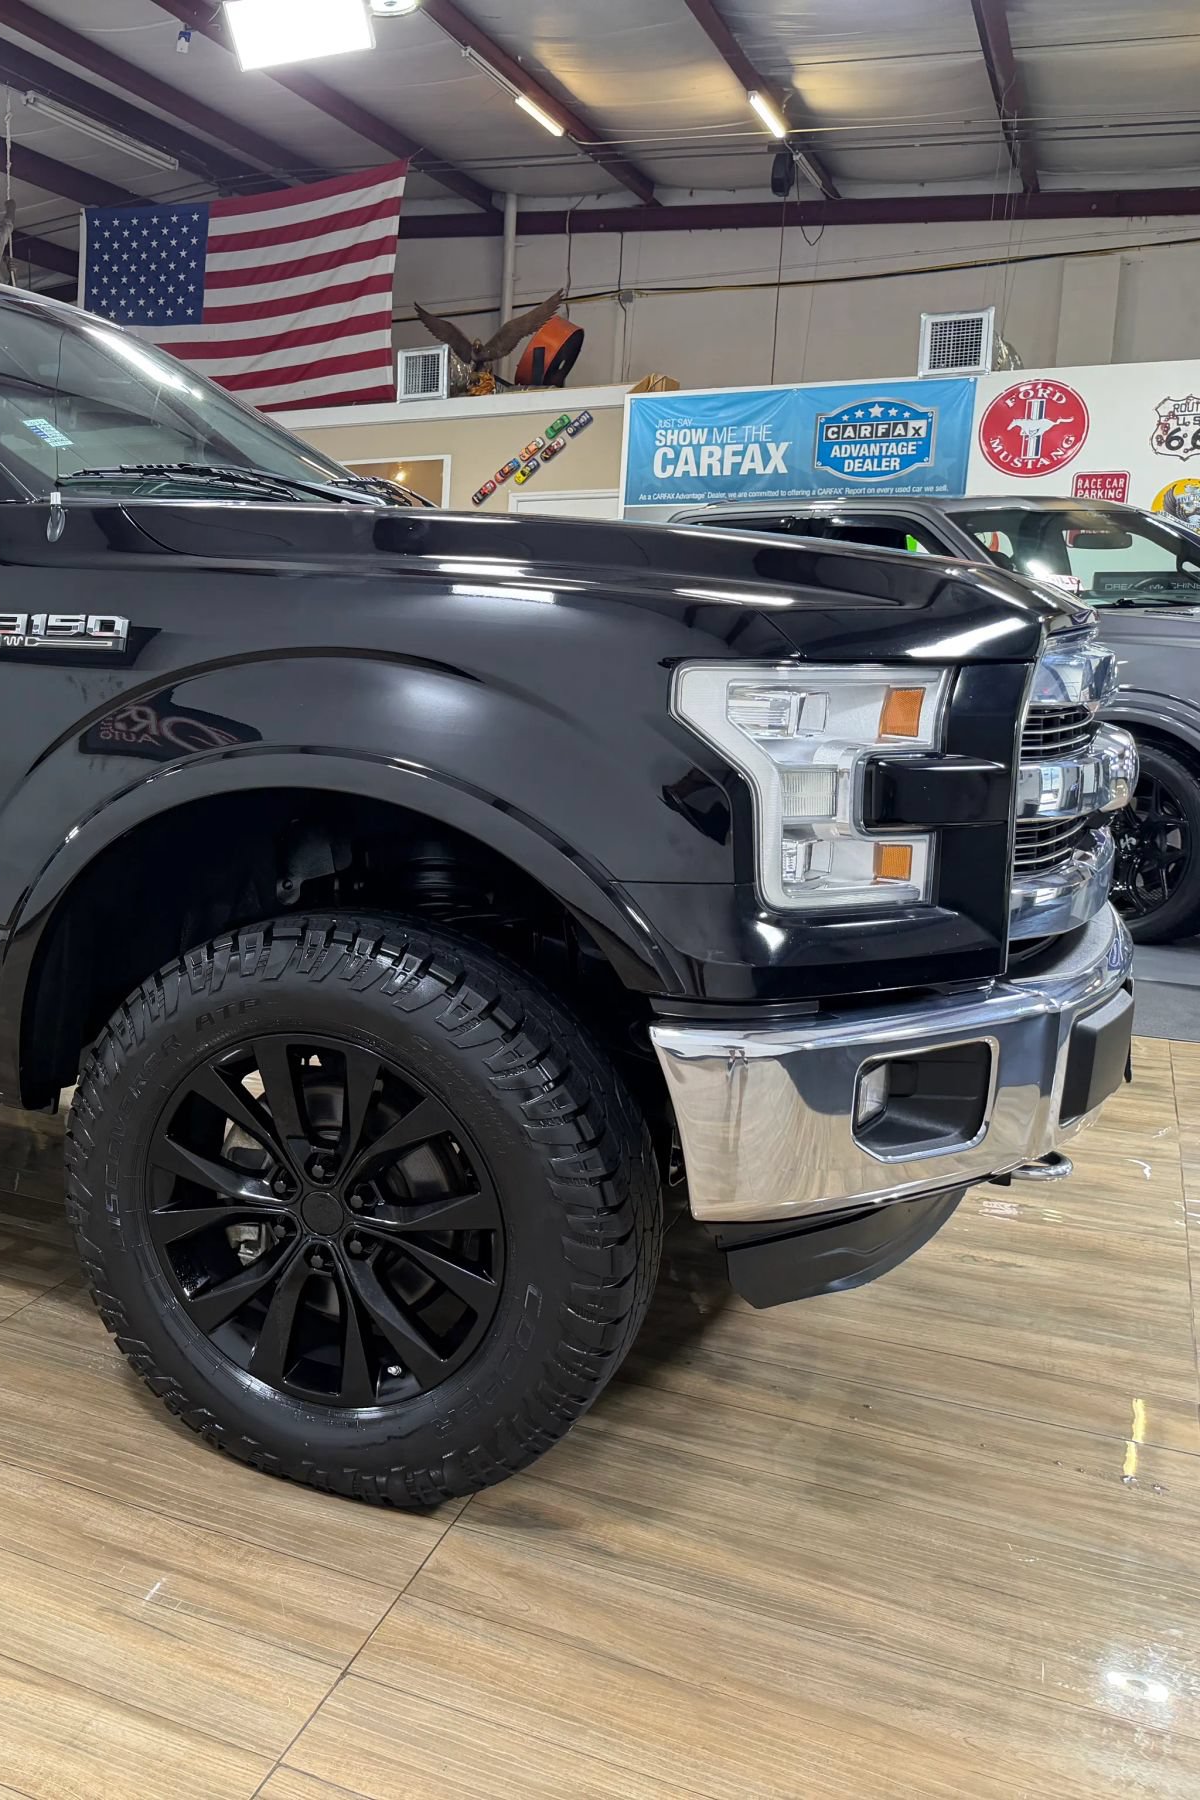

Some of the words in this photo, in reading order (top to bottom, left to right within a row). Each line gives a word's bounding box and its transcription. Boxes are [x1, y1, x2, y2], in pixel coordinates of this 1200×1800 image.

[1005, 388, 1067, 408] FORD
[655, 418, 677, 429] JUST
[825, 423, 923, 440] CARFAX
[655, 428, 708, 447] SHOW
[712, 426, 737, 444] ME
[743, 424, 773, 442] THE
[830, 441, 917, 458] ADVANTAGE
[989, 435, 1076, 469] MUSTANG
[653, 441, 790, 479] CARFAX
[843, 457, 901, 473] DEALER
[1077, 478, 1102, 489] RACE
[1106, 478, 1125, 489] CAR
[639, 493, 647, 501] As
[652, 492, 675, 500] CARFAX
[748, 489, 780, 498] committed
[780, 489, 786, 497] to
[787, 488, 811, 497] offering
[845, 487, 866, 496] Report
[876, 487, 894, 495] every
[895, 485, 911, 493] used
[1076, 489, 1123, 499] PARKING
